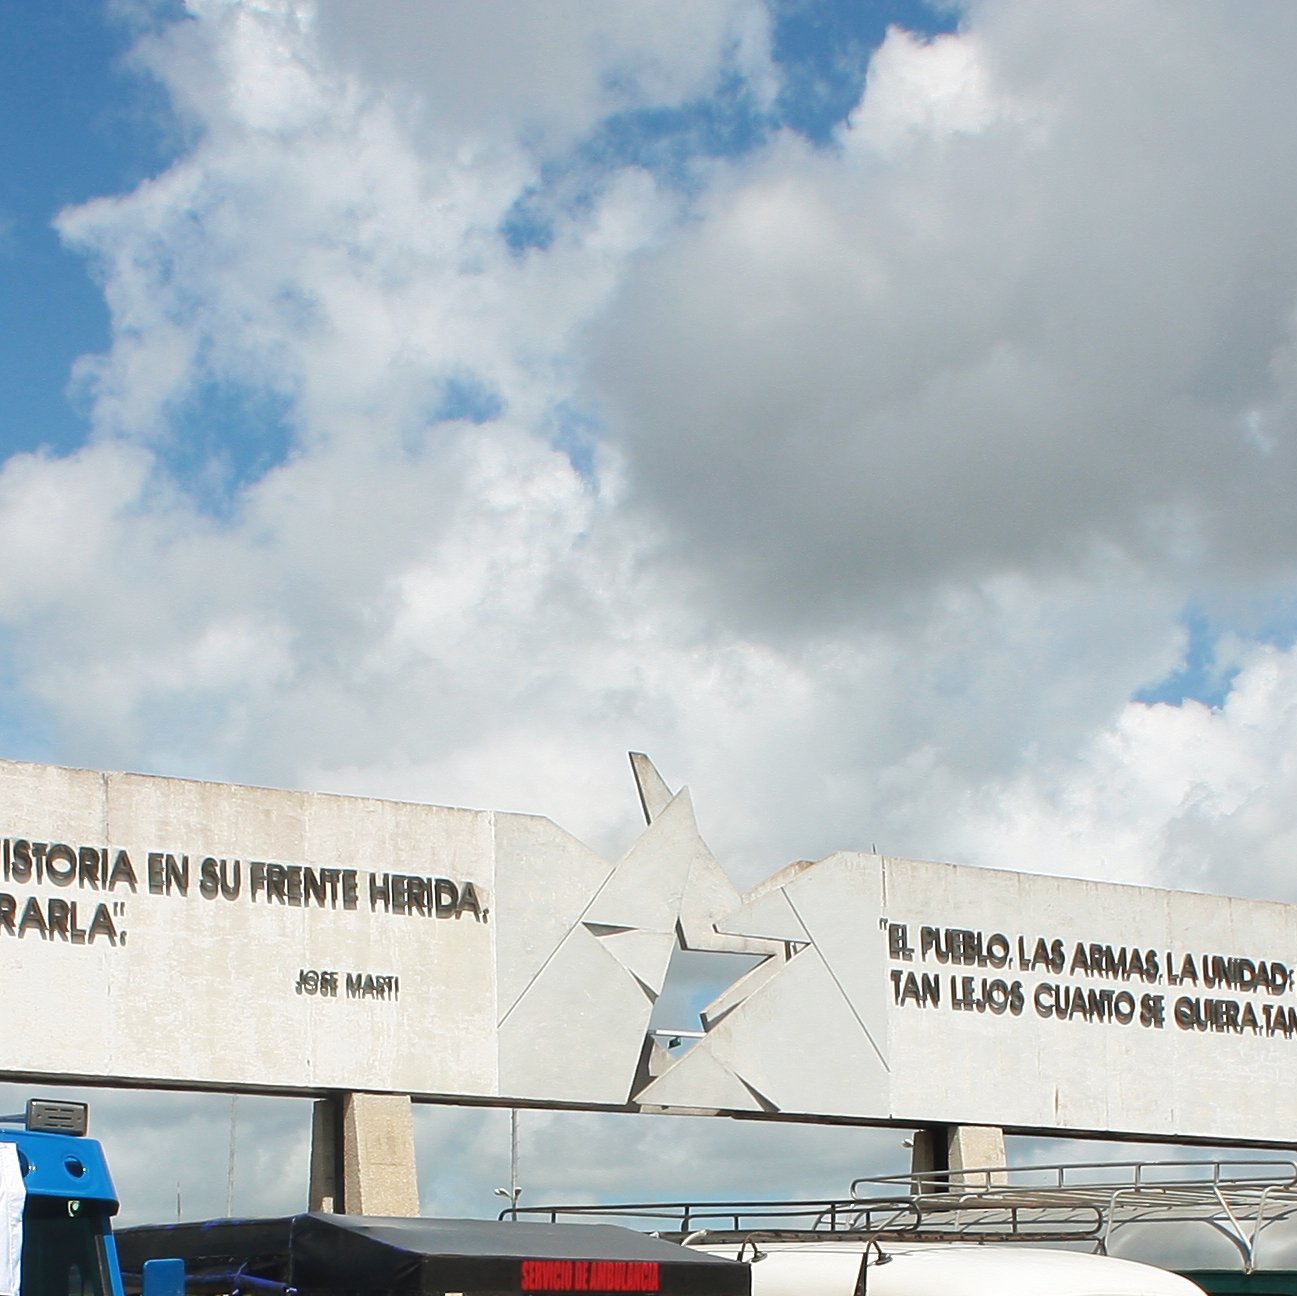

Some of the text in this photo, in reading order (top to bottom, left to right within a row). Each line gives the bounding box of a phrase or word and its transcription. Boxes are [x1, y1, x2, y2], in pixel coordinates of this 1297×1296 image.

[148, 852, 189, 897] EN
[200, 856, 241, 901] SU
[250, 862, 358, 911] FRENTE
[294, 968, 400, 1002] JOSE MARTI
[1018, 935, 1065, 975] LAS
[1166, 952, 1198, 988] LA
[890, 970, 939, 1009] TAN
[950, 975, 1024, 1016] LEJOS
[1034, 982, 1135, 1025] CUANTO
[1140, 992, 1164, 1029] SE
[521, 1261, 660, 1292] SERVICIO DE AMBULANCIA
